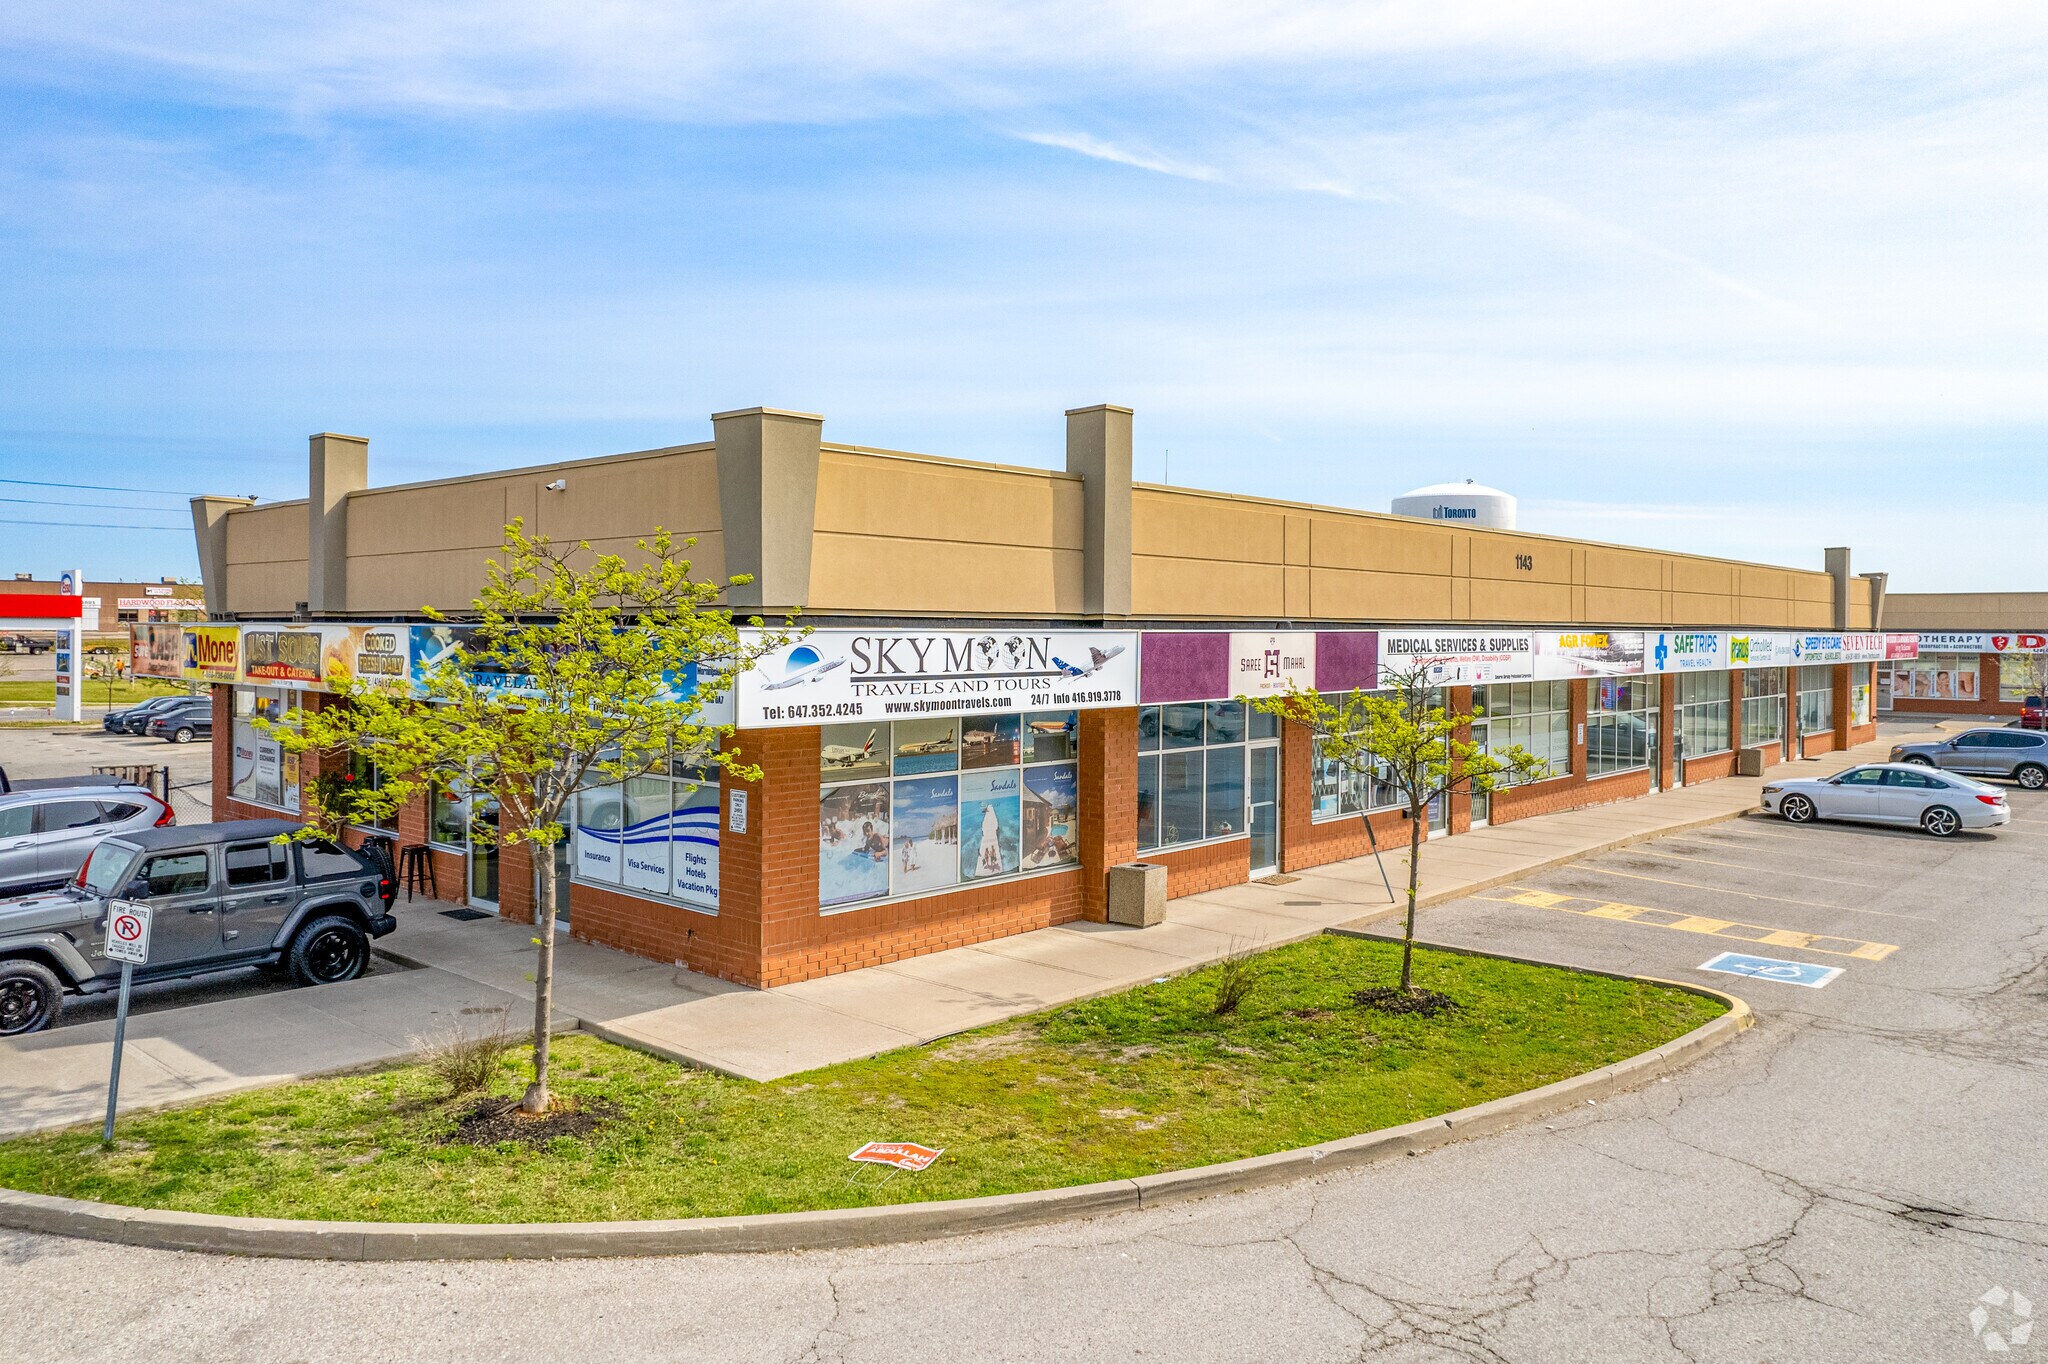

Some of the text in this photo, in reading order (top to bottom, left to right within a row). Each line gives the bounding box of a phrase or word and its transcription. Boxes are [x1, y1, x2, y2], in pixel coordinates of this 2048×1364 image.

[1515, 554, 1533, 571] 1143
[365, 635, 396, 652] COOKED
[1387, 637, 1529, 653] MEDICAL SERVICES & SUPPLIES
[1559, 634, 1609, 648] AGR FOREX
[1750, 637, 1772, 652] OrthoMed
[1805, 637, 1821, 650] SPEEDY
[1842, 636, 1864, 651] SEVEN
[1865, 635, 1883, 650] TECH
[246, 633, 320, 665] JUST SOUPS
[358, 655, 405, 675] FRESH DAILY
[1240, 657, 1306, 672] SAREE MAHAL
[1680, 659, 1712, 668] TRAVEL HEALTH
[251, 665, 316, 679] TAKE-OUT & CATERING
[851, 678, 1051, 697] TRAVELS AND TOURS
[885, 696, 1012, 713] www.skymoontravels.com
[1031, 690, 1121, 705] 24/7 Info 416.919.3778
[763, 703, 863, 720] Tel: 647.352.4245
[1053, 771, 1073, 781] Sandals
[990, 779, 1017, 792] Sandals
[930, 788, 954, 799] Sandals
[584, 850, 611, 863] Insurance
[685, 852, 706, 866] Flights
[627, 858, 665, 874] Visa Services
[686, 867, 706, 879] Hotels
[677, 879, 718, 898] Vacation Pkg
[113, 905, 148, 918] FIRE ROUTE
